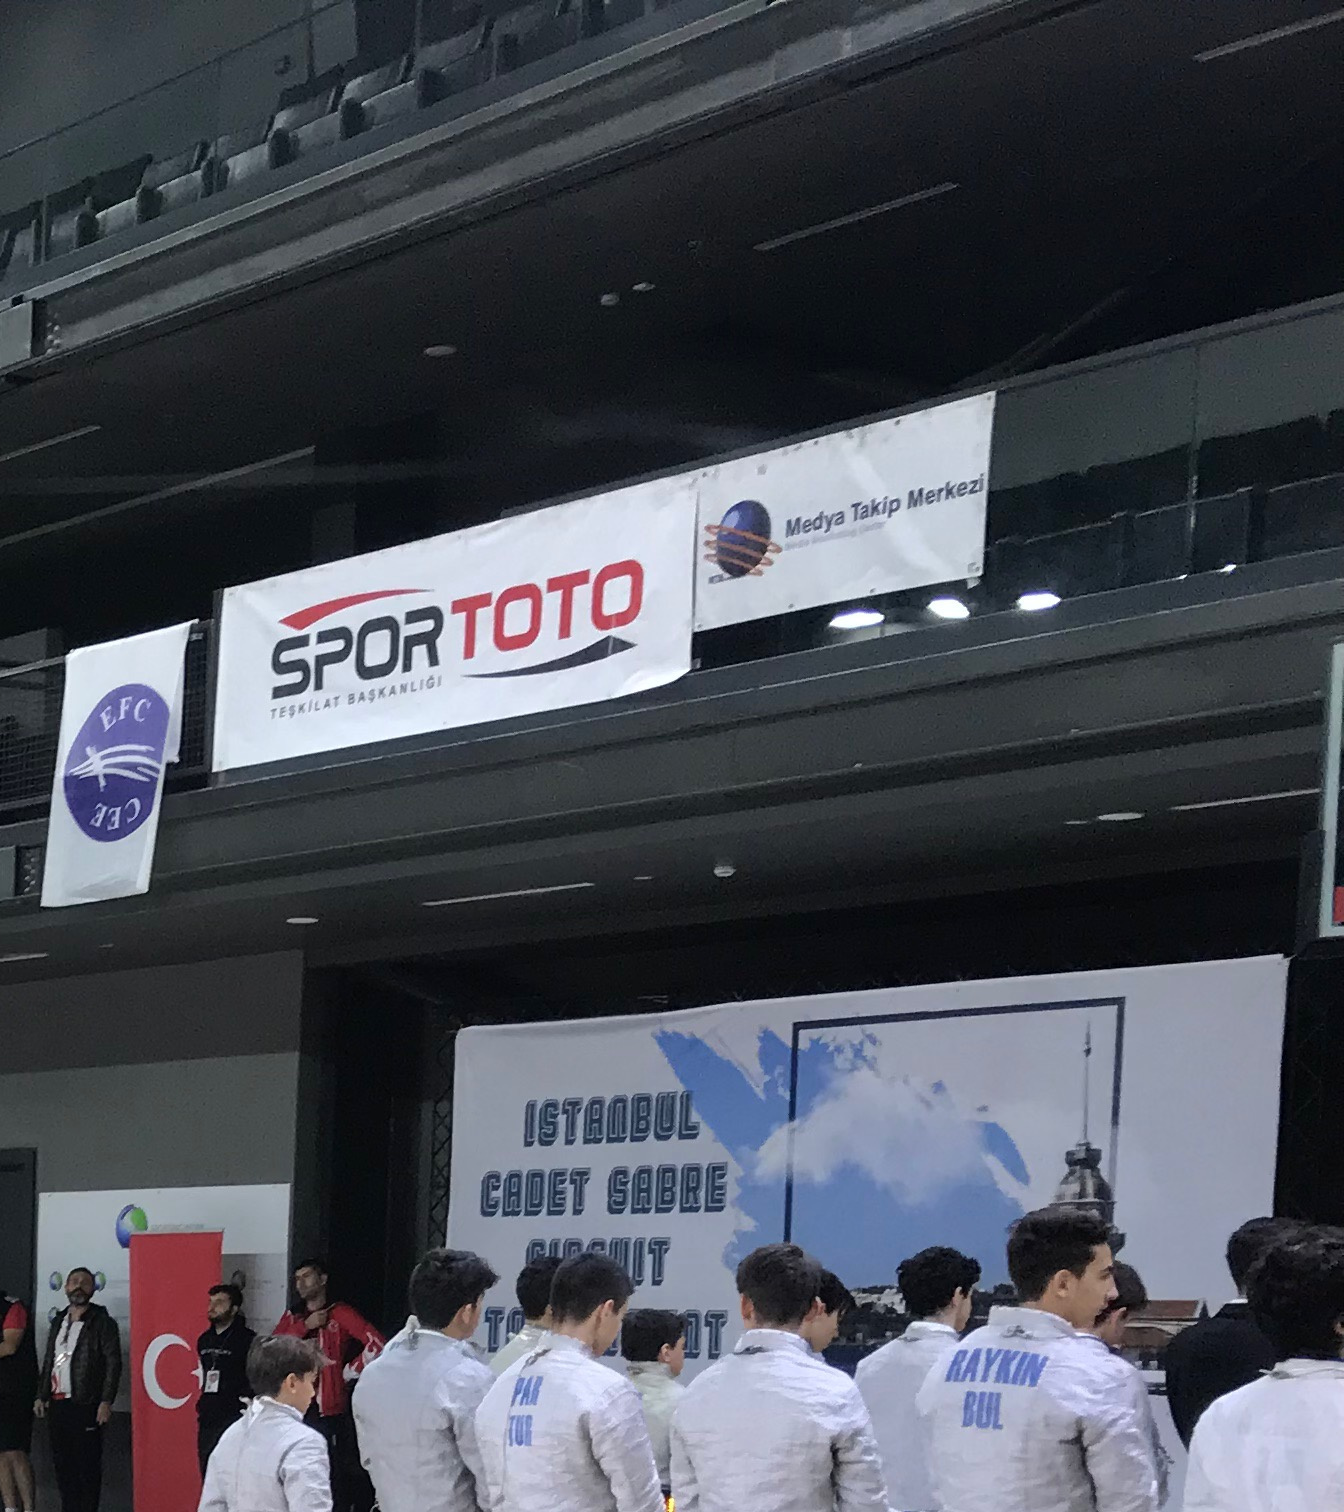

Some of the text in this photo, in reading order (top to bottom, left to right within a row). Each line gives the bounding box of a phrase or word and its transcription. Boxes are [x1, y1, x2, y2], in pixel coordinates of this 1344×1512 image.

[784, 510, 845, 538] Medya
[850, 496, 901, 521] Takip
[906, 473, 985, 510] Merkezi
[98, 696, 152, 732] EFC
[270, 675, 443, 719] TEŞKİLAT BAŞKANLIĞI
[523, 1089, 701, 1148] ISTANBUL
[480, 1161, 728, 1217] CADET SABRE
[961, 1390, 1004, 1430] BUL
